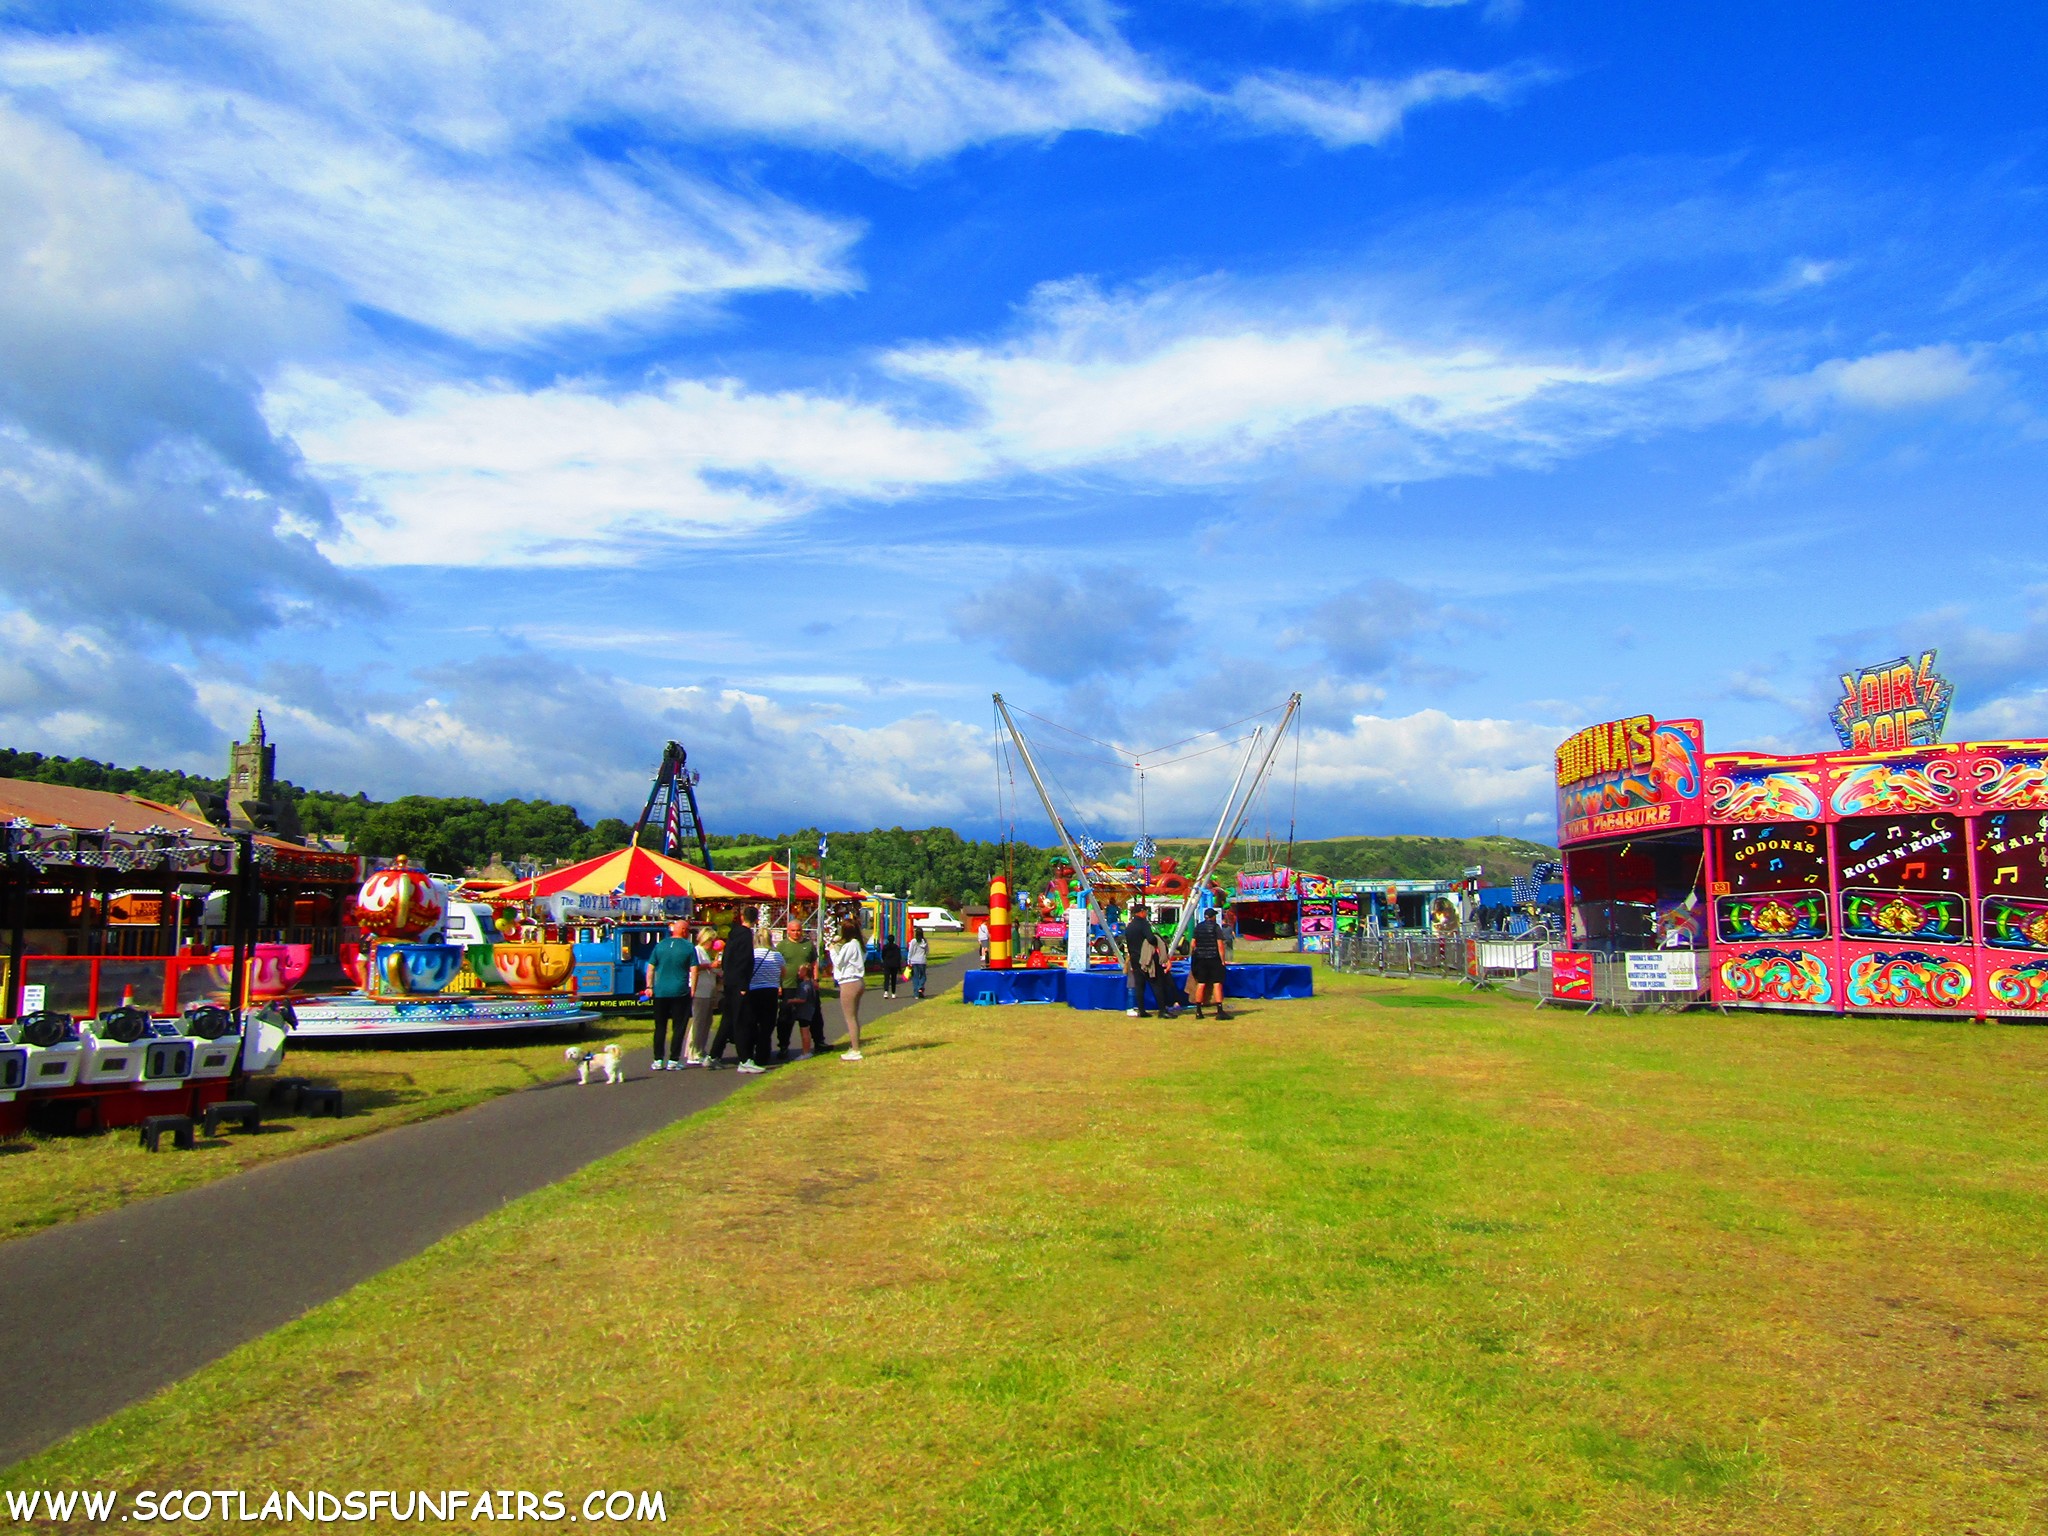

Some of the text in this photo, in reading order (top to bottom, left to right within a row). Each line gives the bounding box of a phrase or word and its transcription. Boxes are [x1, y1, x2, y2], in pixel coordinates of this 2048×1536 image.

[1860, 664, 1917, 717] AIR
[1852, 708, 1928, 750] RAI
[1593, 805, 1671, 832] PLEASURE
[561, 897, 574, 906] The
[579, 895, 610, 910] ROYAL
